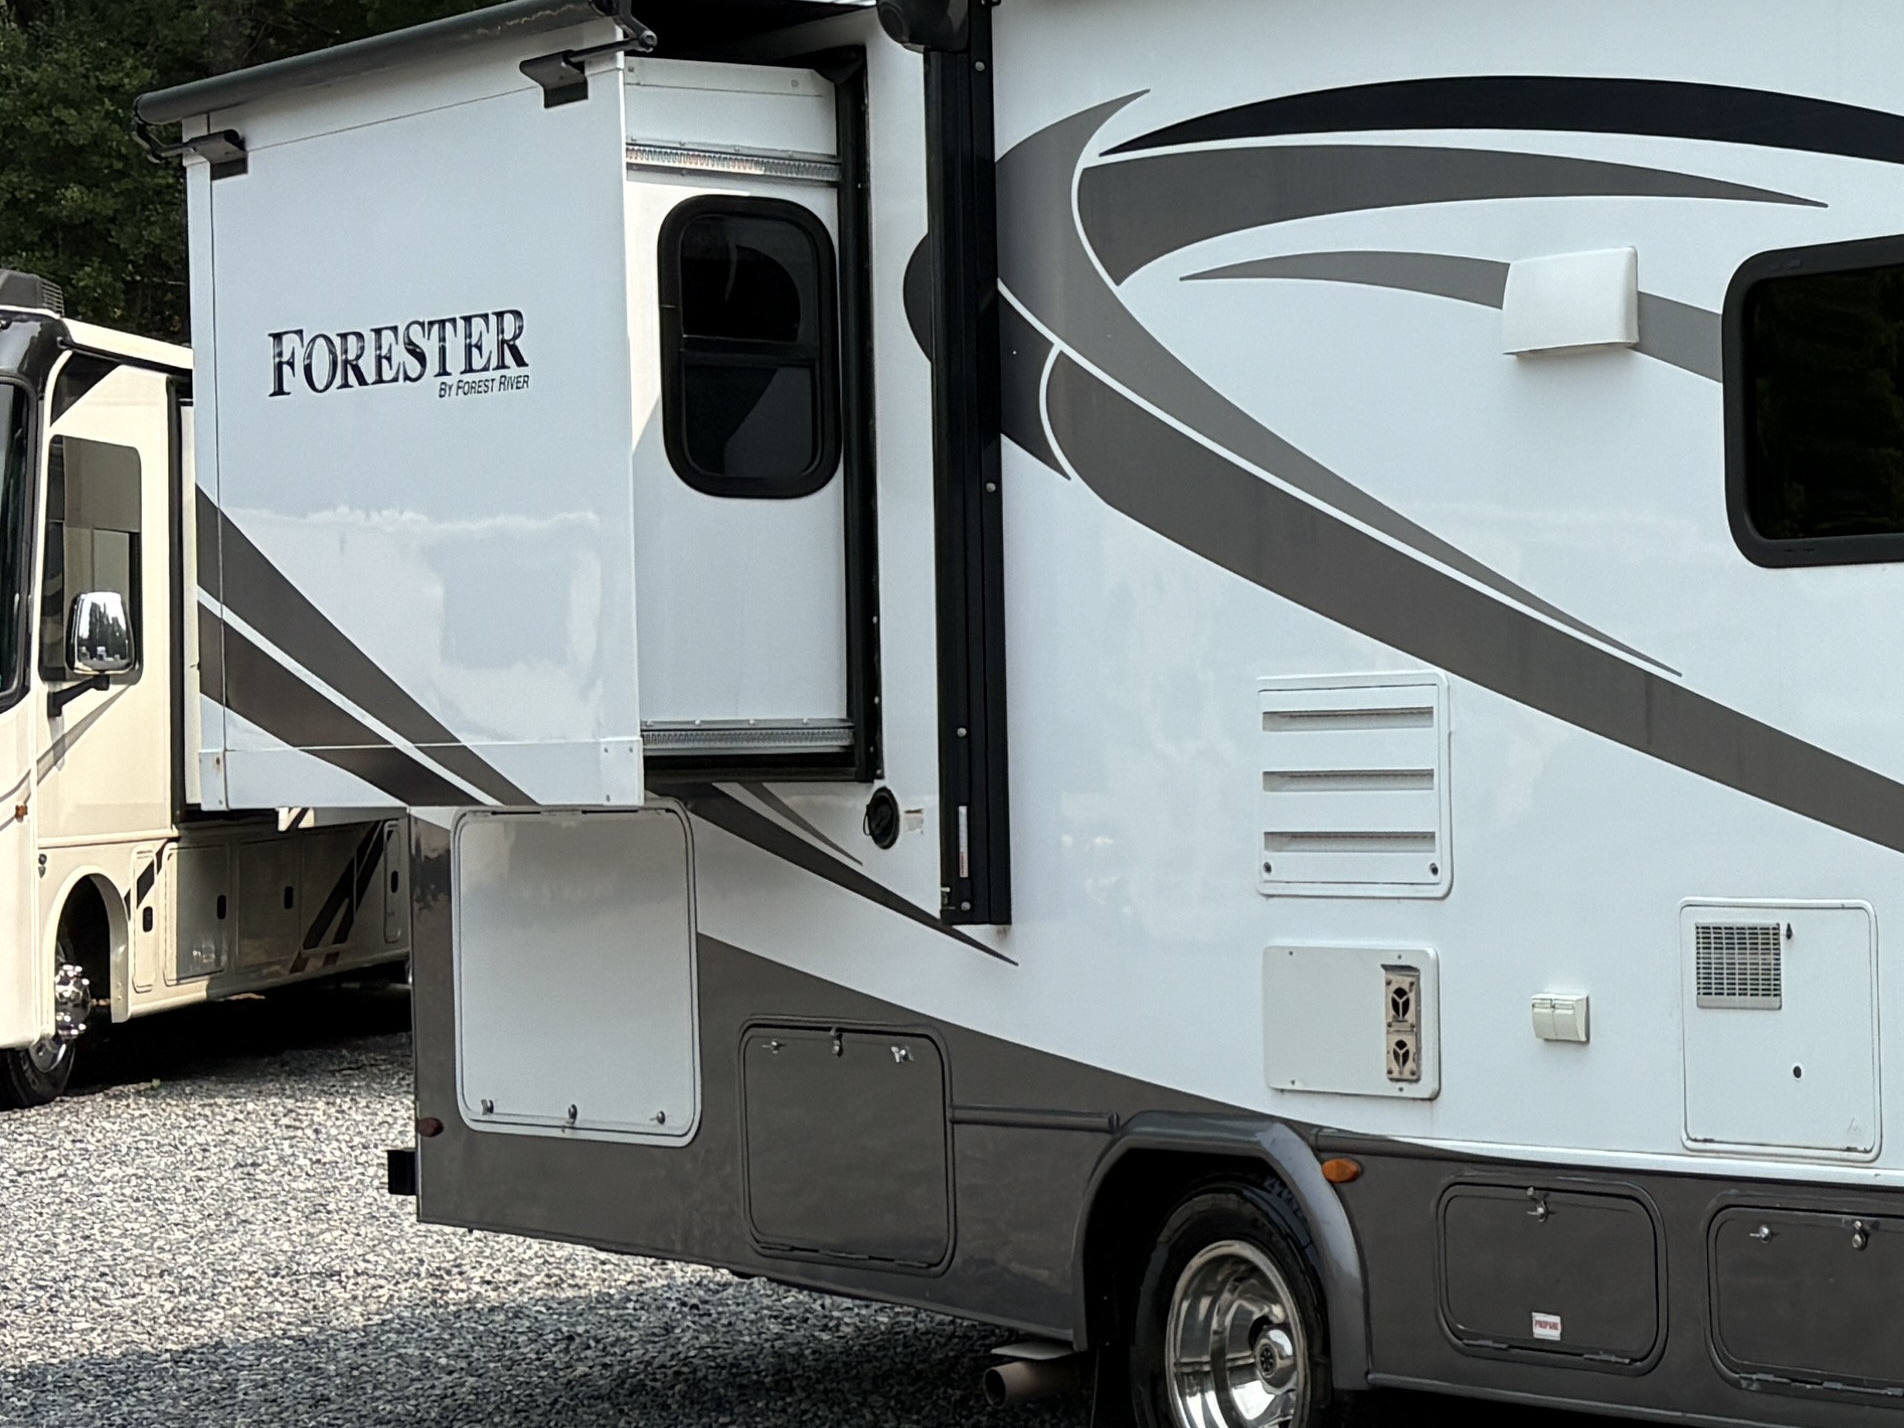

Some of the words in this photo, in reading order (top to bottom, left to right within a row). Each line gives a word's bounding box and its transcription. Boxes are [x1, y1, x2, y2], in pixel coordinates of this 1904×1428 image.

[268, 309, 529, 397] FORESTER
[439, 381, 453, 398] BY
[455, 377, 495, 397] FOREST
[498, 374, 530, 392] RIVER
